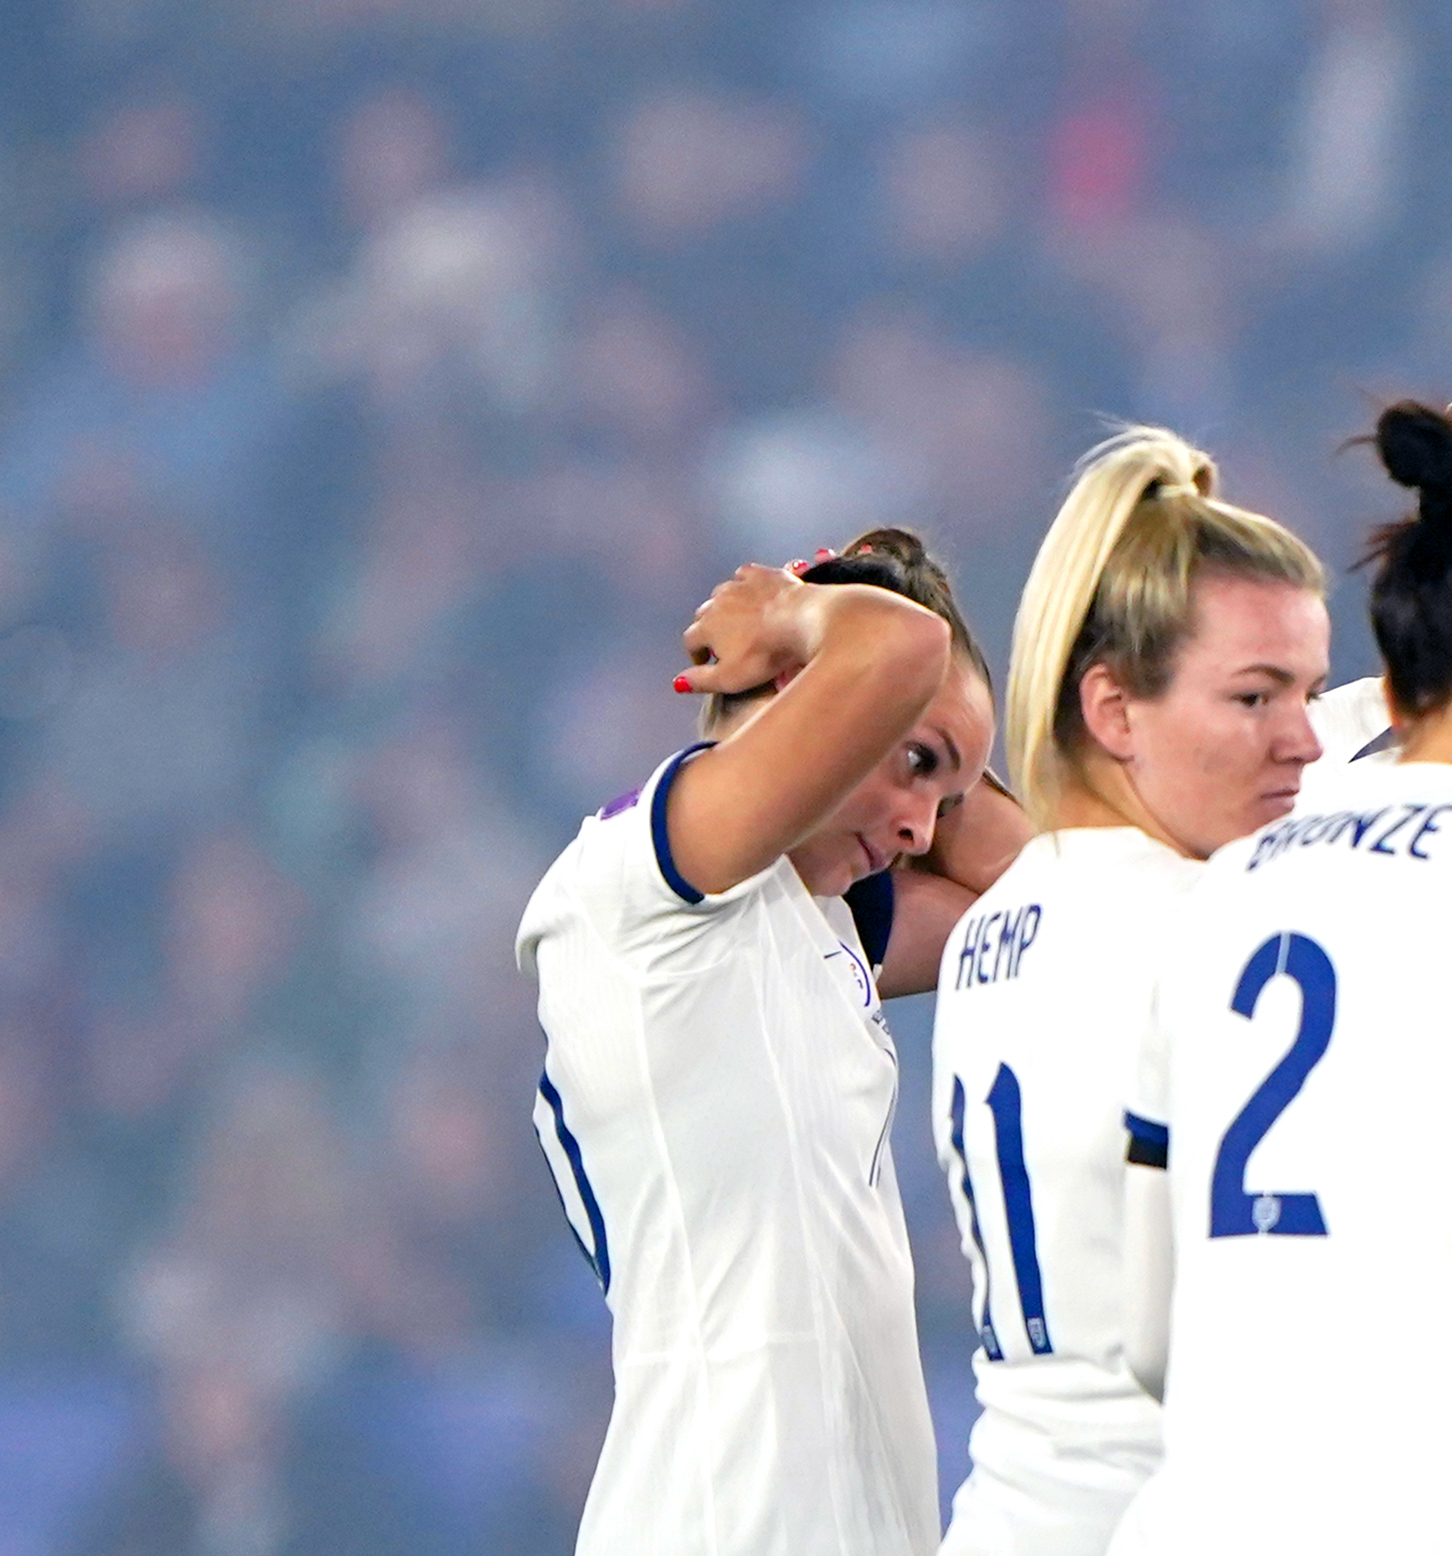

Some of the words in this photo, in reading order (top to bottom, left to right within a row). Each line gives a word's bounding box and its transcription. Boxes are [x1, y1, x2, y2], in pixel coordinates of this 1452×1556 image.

[954, 904, 1043, 991] HEMP
[1209, 931, 1338, 1238] 2
[951, 1061, 1053, 1361] 11
